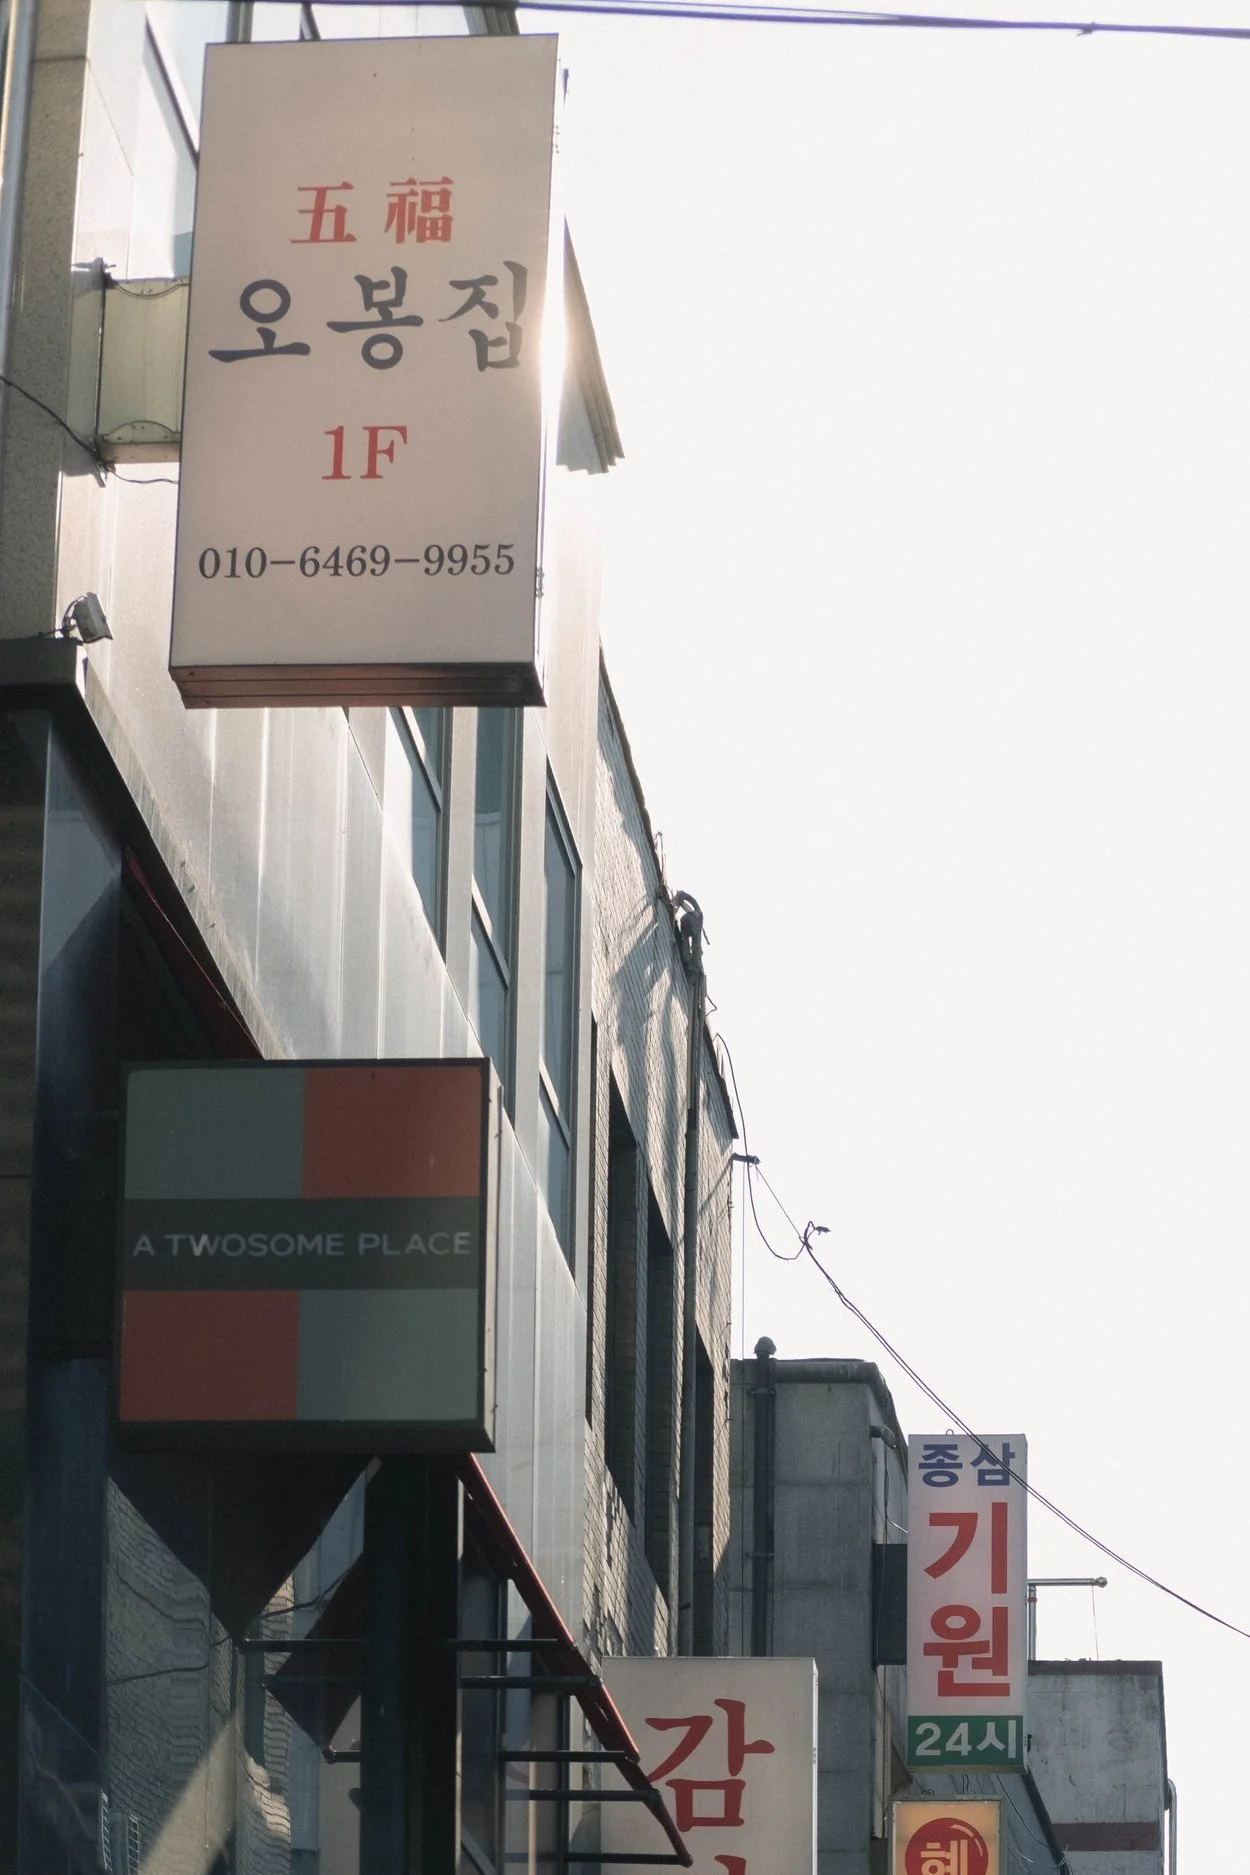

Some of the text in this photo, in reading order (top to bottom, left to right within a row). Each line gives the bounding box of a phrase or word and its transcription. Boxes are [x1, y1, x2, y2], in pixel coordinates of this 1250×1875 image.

[208, 260, 529, 372] 오봉집
[321, 425, 408, 481] 1F
[198, 542, 516, 580] 010-6469-9955
[132, 1231, 473, 1258] A TWOSOME PLACE
[918, 1440, 1028, 1490] 종삼
[922, 1501, 1011, 1698] 기원
[915, 1717, 1019, 1764] 24시
